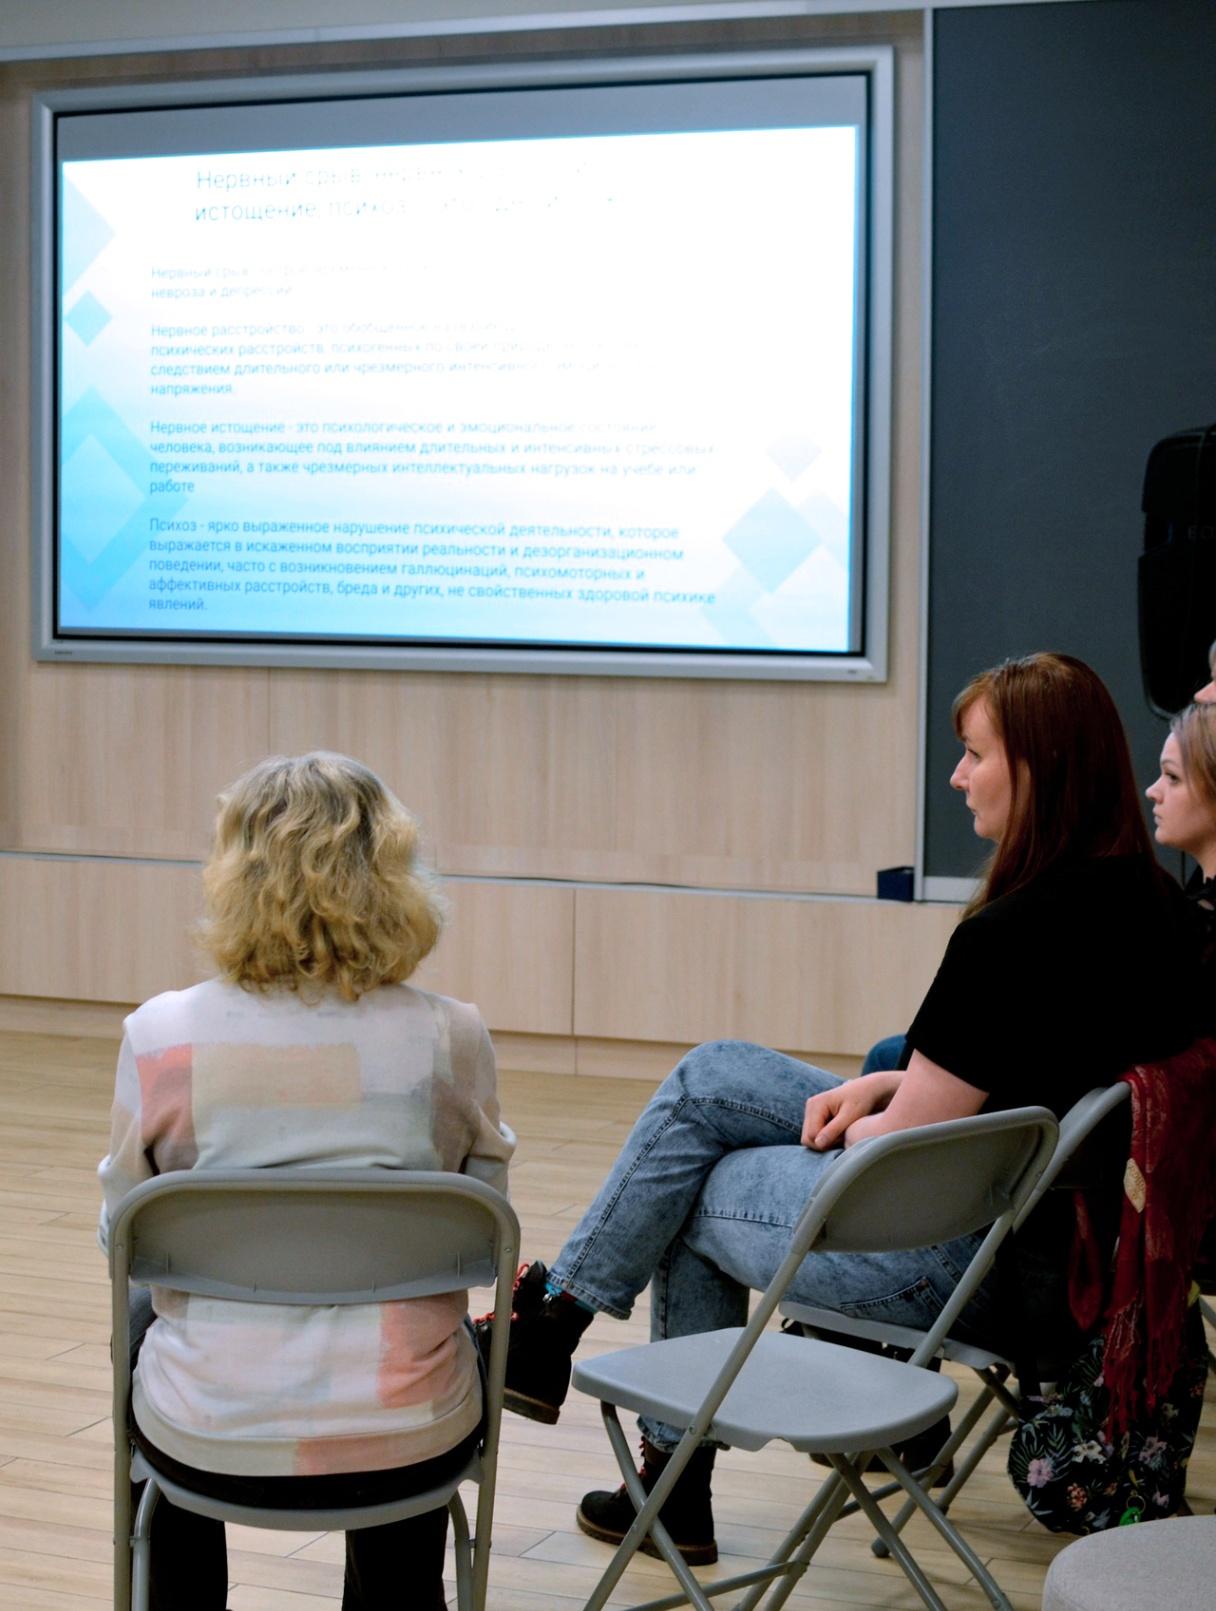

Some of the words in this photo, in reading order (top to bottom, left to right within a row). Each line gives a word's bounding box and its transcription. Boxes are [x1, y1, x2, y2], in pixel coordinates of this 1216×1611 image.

[151, 325, 207, 338] Нервное
[151, 344, 233, 356] психических
[151, 363, 230, 376] следствием
[234, 362, 321, 376] длительного
[324, 362, 349, 373] или
[150, 421, 207, 435] Нервное
[211, 422, 284, 434] истощение
[296, 422, 319, 433] это
[322, 422, 442, 433] психологическое
[447, 423, 455, 433] и
[219, 442, 313, 454] возникающее
[317, 442, 342, 454] под
[346, 442, 416, 453] влиянием
[419, 443, 506, 455] длительных
[511, 443, 520, 453] и
[150, 460, 243, 475] переживаний,
[247, 463, 254, 472] а
[258, 462, 299, 473] также
[303, 462, 388, 475] чрезмерных
[392, 463, 525, 477] интеллектуальных
[150, 518, 197, 531] Психоз
[208, 521, 239, 534] ярко
[242, 521, 329, 535] выраженное
[333, 522, 410, 536] нарушение
[414, 521, 505, 536] психической
[619, 527, 679, 541] которое
[149, 539, 231, 553] выражается
[235, 542, 243, 551] в
[246, 542, 332, 553] искаженном
[336, 543, 419, 556] восприятии
[422, 544, 506, 558] реальности
[510, 546, 519, 556] и
[523, 546, 684, 560] дезорганизационном
[149, 559, 224, 572] поведении,
[227, 561, 265, 572] часто
[268, 562, 275, 572] с
[280, 562, 397, 574] возникновением
[401, 563, 511, 579] галлюцинаций,
[514, 566, 631, 581] психомоторных
[636, 569, 645, 580] и
[149, 576, 241, 592] аффективных
[244, 579, 334, 594] расстройств,
[337, 580, 377, 595] бреда
[382, 585, 390, 594] и
[394, 584, 444, 598] других,
[448, 586, 464, 597] не
[468, 584, 572, 599] свойственных
[578, 588, 649, 602] здоровой
[654, 592, 716, 604] психике
